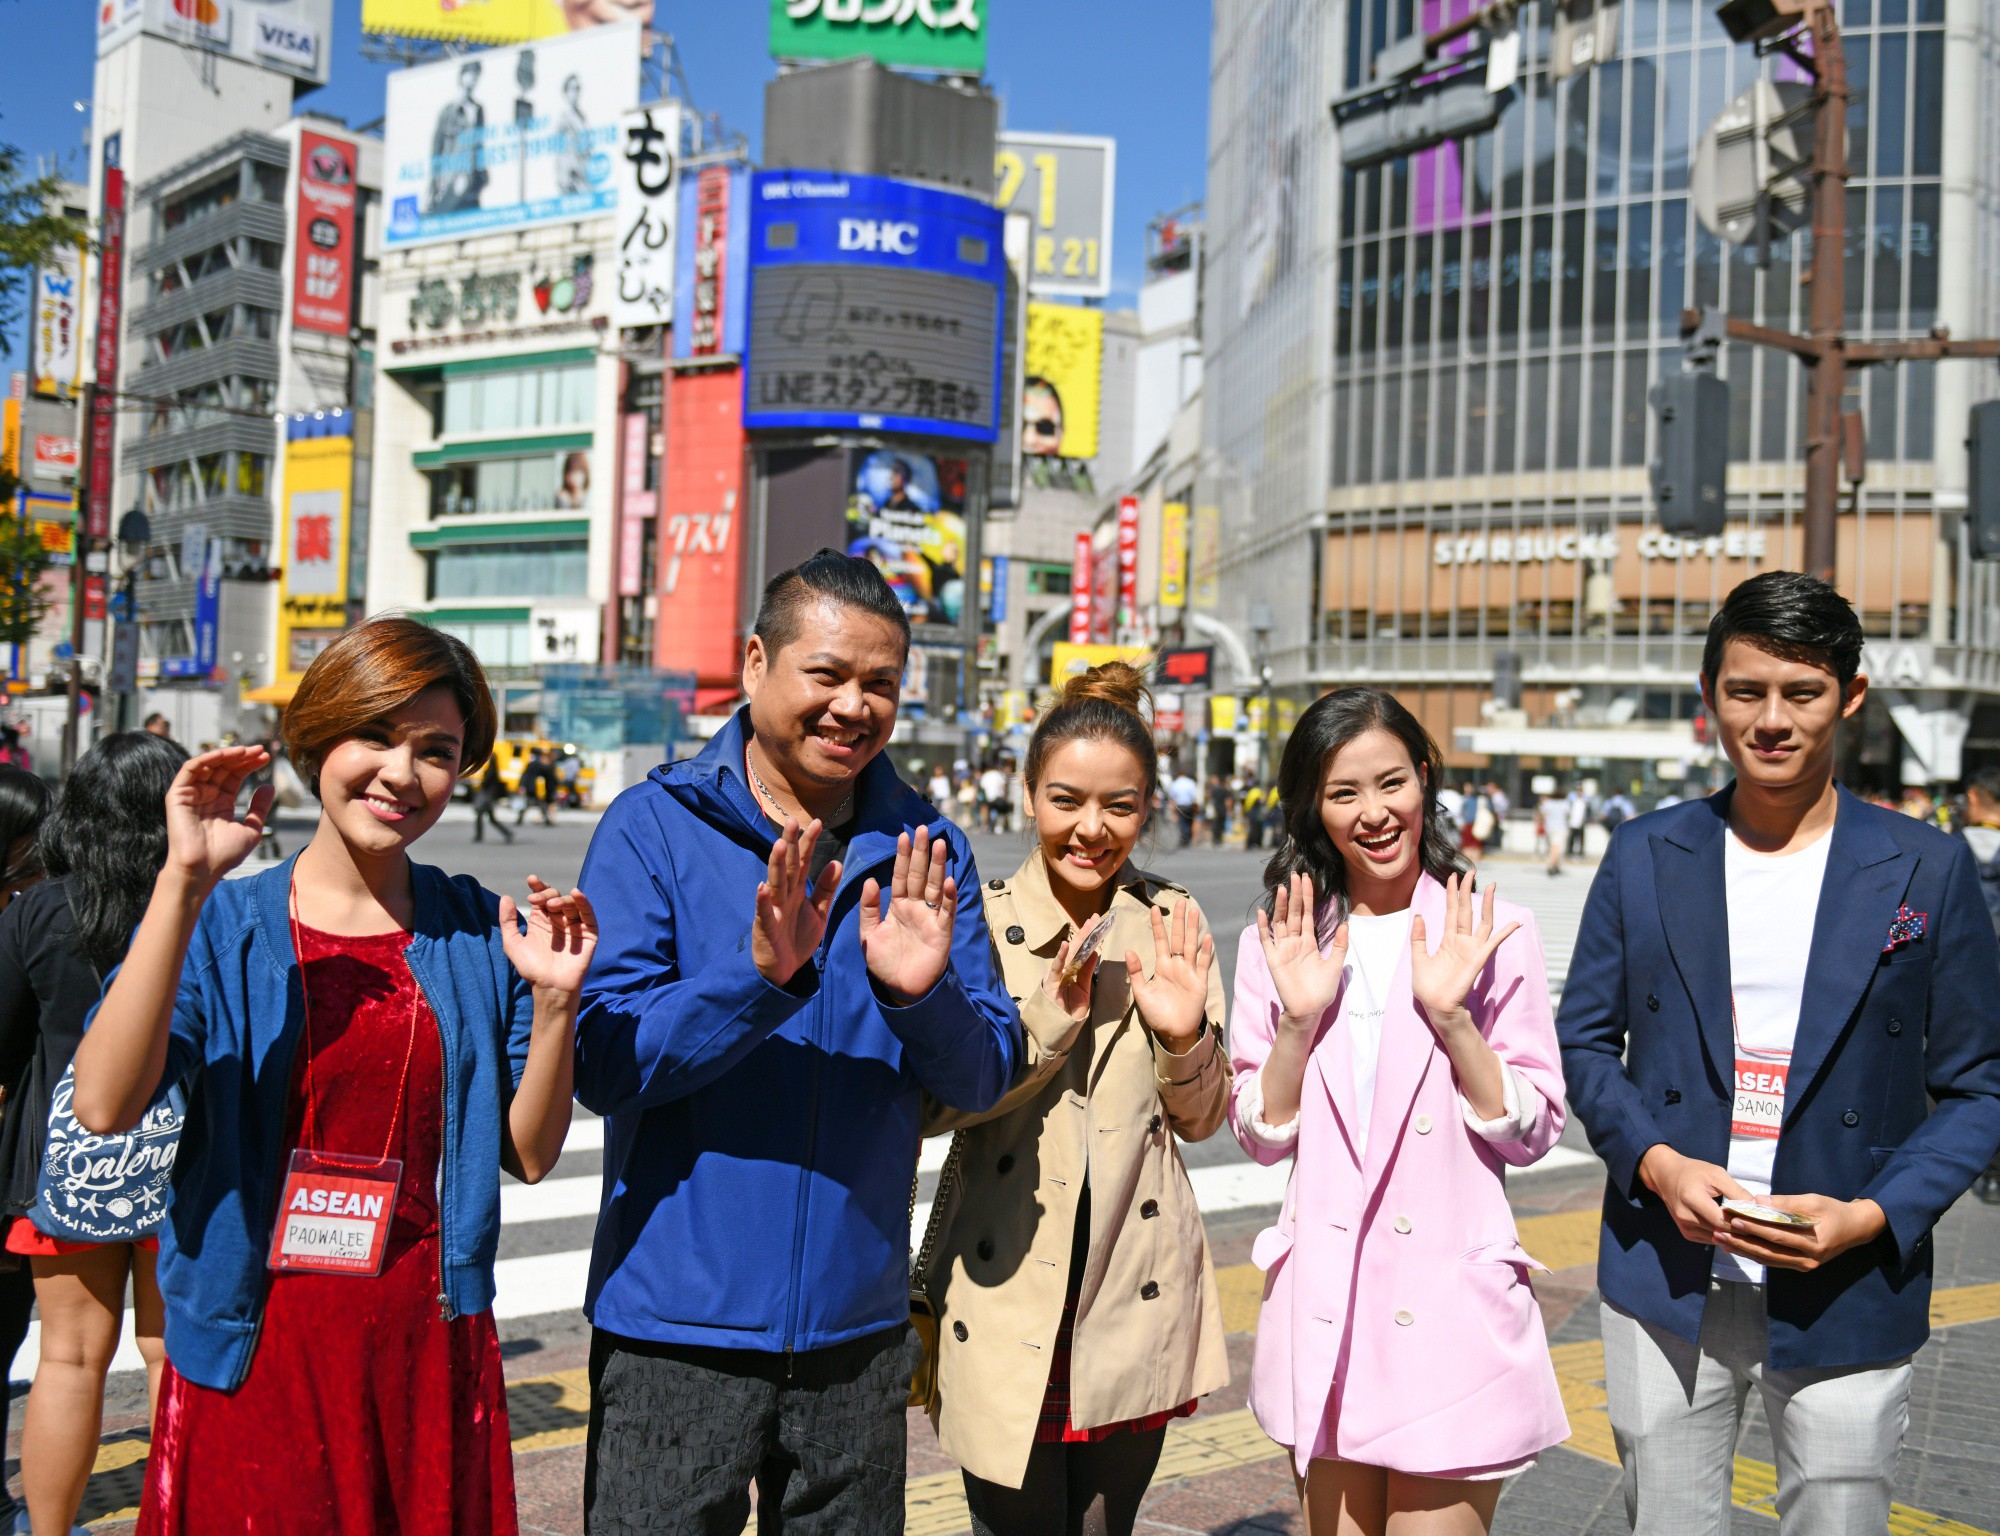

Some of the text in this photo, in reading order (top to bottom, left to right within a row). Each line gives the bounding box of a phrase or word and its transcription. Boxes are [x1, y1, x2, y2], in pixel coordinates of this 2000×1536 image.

[258, 22, 311, 52] VISA
[619, 111, 673, 313] もんじゃ
[838, 218, 919, 255] DHC
[665, 488, 737, 594] クスリ
[1433, 534, 1619, 564] STARBUCKS
[289, 1187, 384, 1218] ASEAN
[289, 1226, 364, 1246] PAOWALEE
